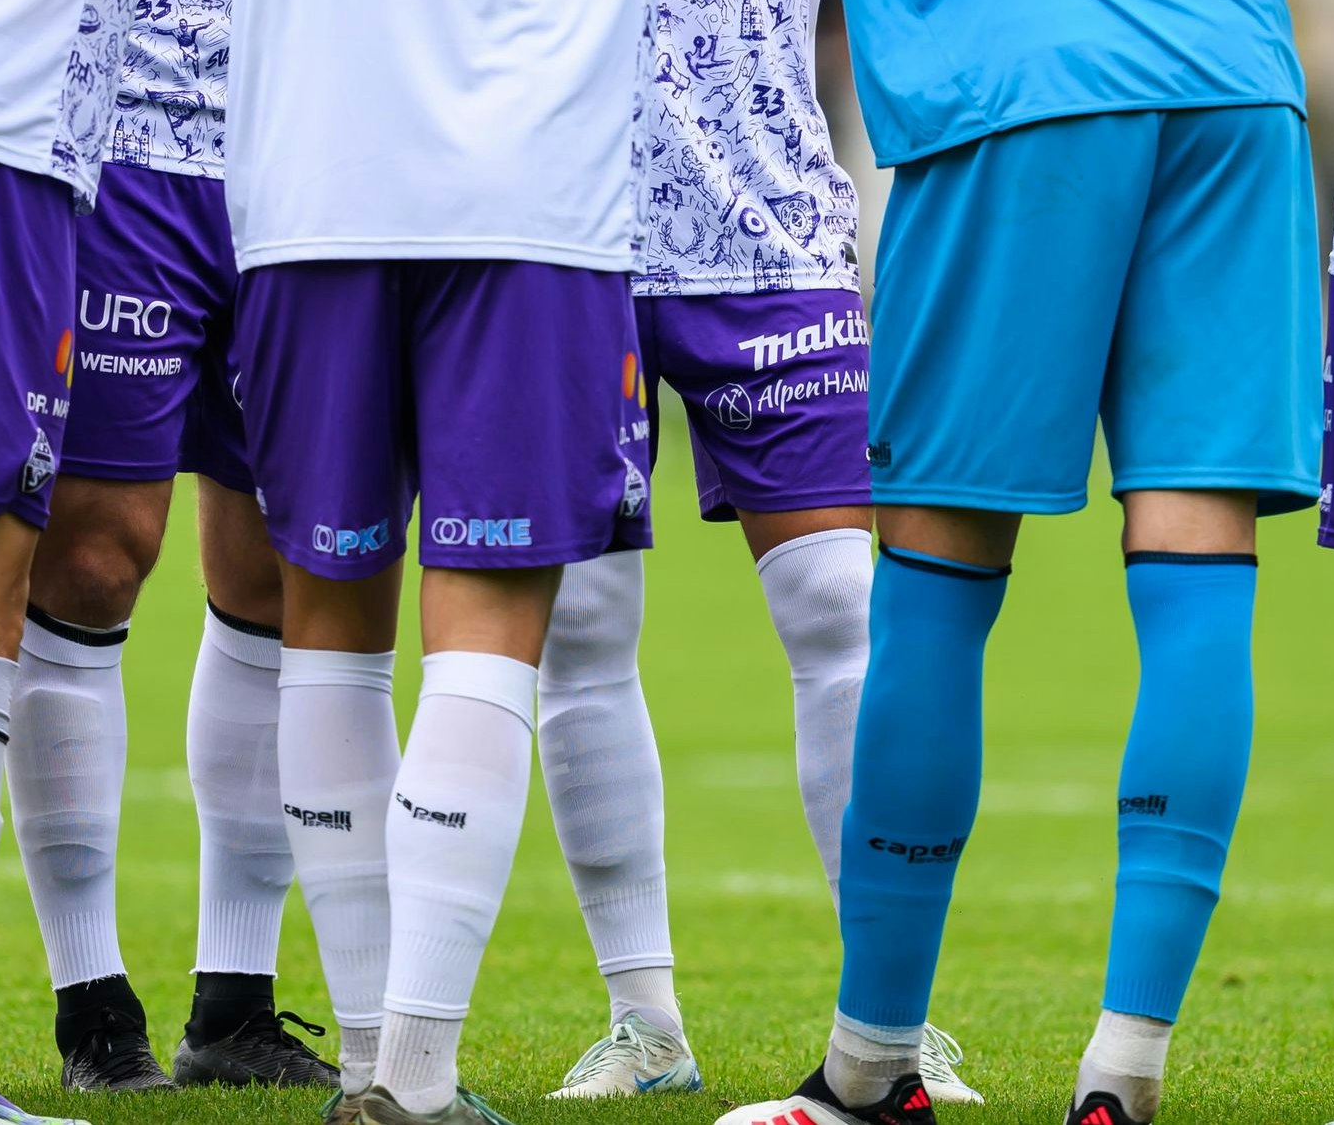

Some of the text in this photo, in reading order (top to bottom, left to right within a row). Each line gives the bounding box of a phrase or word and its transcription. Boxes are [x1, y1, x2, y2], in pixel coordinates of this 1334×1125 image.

[750, 83, 786, 119] 33
[79, 289, 172, 338] URO
[737, 310, 870, 372] makit
[80, 351, 182, 376] WEINKAMER
[823, 369, 869, 396] HAM
[467, 518, 533, 547] PKE
[284, 803, 353, 827] capelli
[396, 792, 467, 826] capelli
